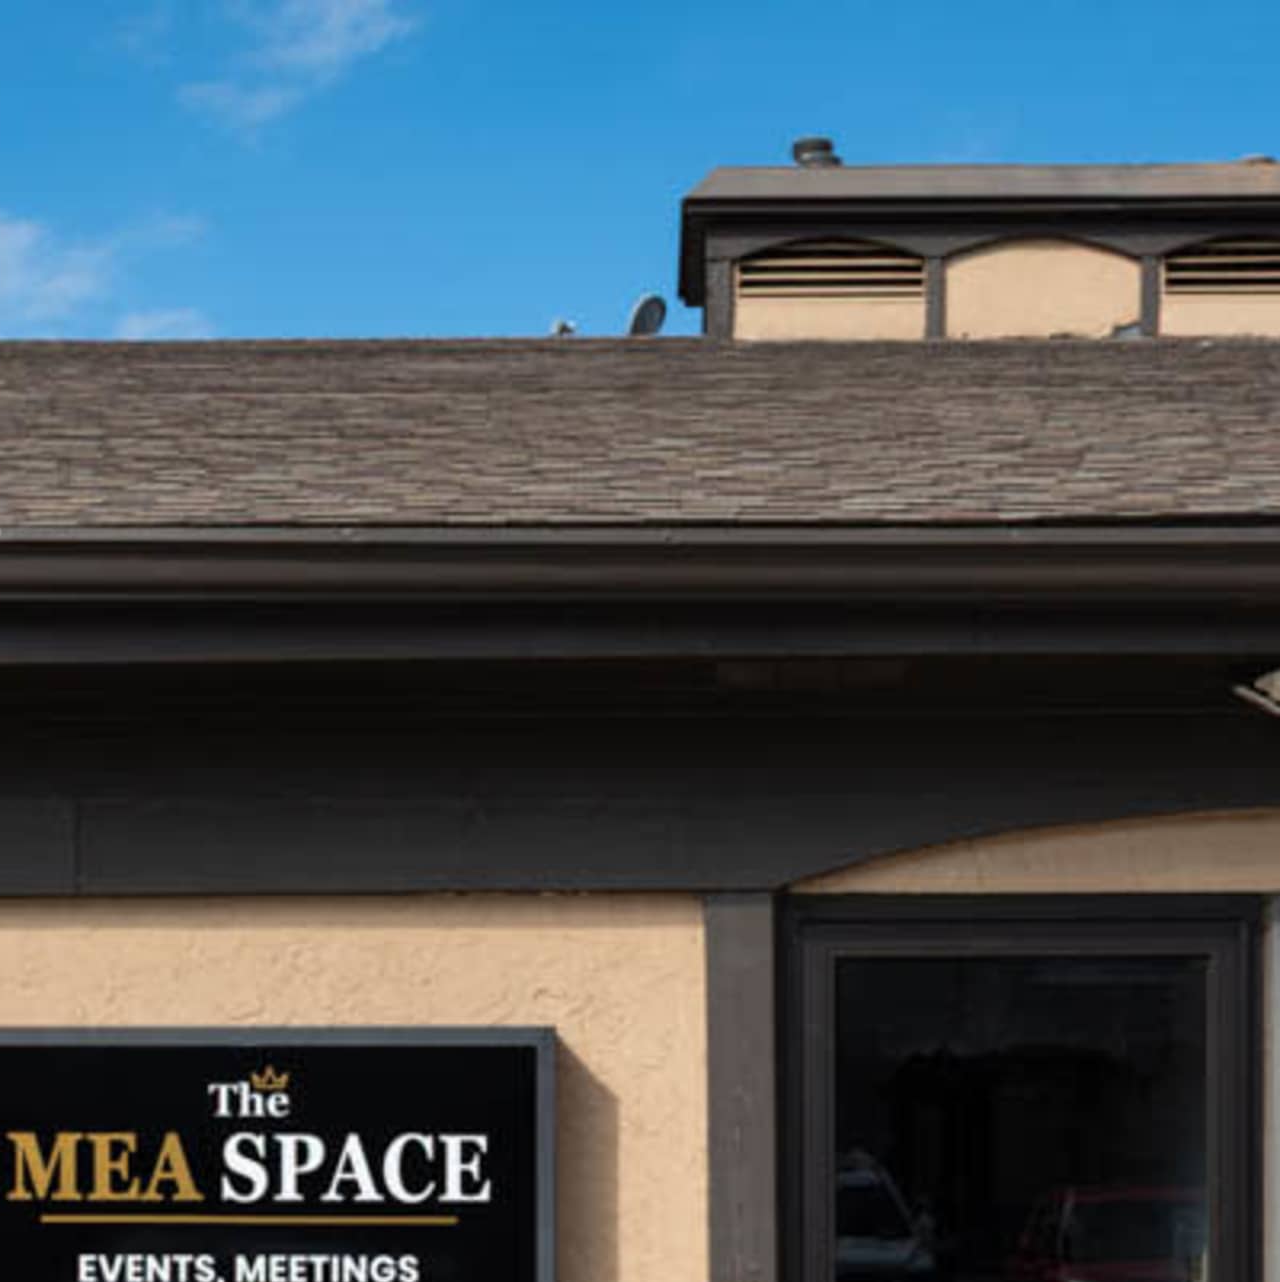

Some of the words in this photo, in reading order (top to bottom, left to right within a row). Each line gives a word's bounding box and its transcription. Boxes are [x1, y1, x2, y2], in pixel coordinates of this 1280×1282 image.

[208, 1081, 289, 1117] The
[8, 1132, 203, 1200] MEA
[221, 1132, 491, 1203] SPACE
